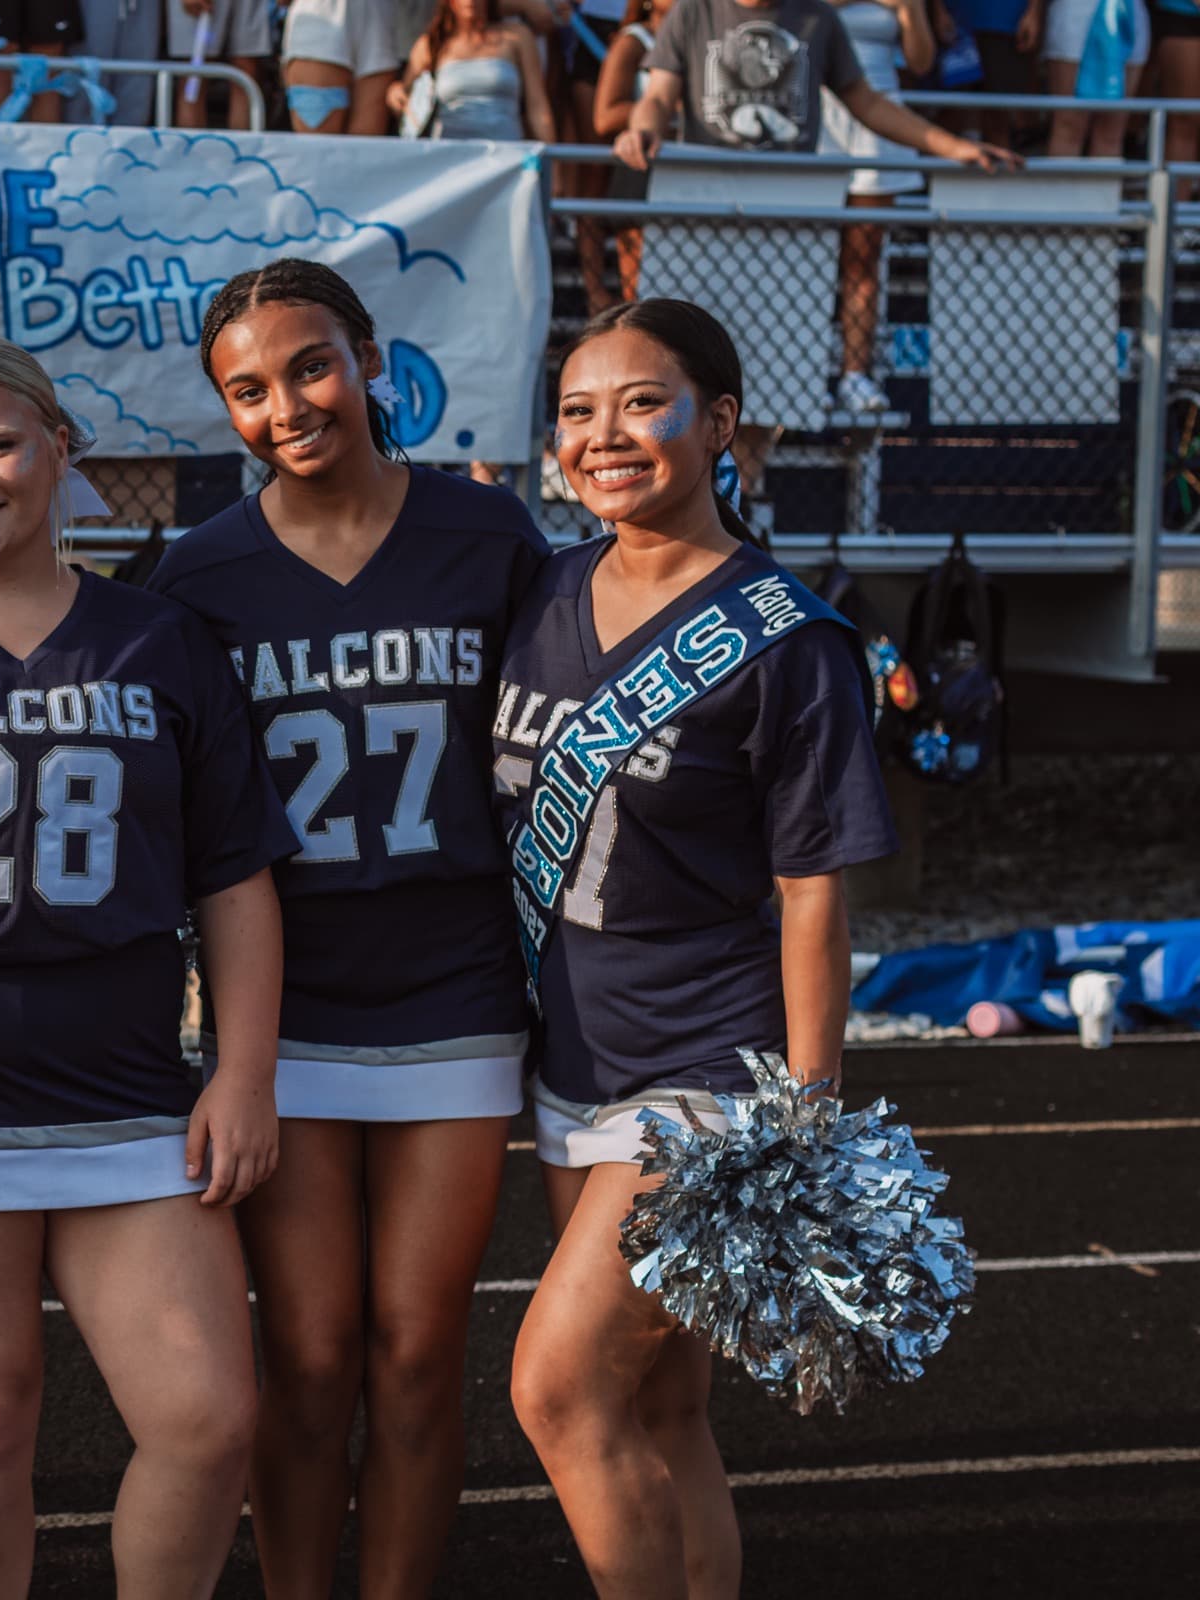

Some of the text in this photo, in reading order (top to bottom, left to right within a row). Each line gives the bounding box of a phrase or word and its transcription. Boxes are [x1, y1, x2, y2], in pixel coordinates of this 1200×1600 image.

[0, 254, 228, 353] Bett
[739, 574, 806, 637] Mang
[264, 699, 448, 865] 27
[511, 603, 748, 911] SENIOR
[512, 876, 548, 952] 2027
